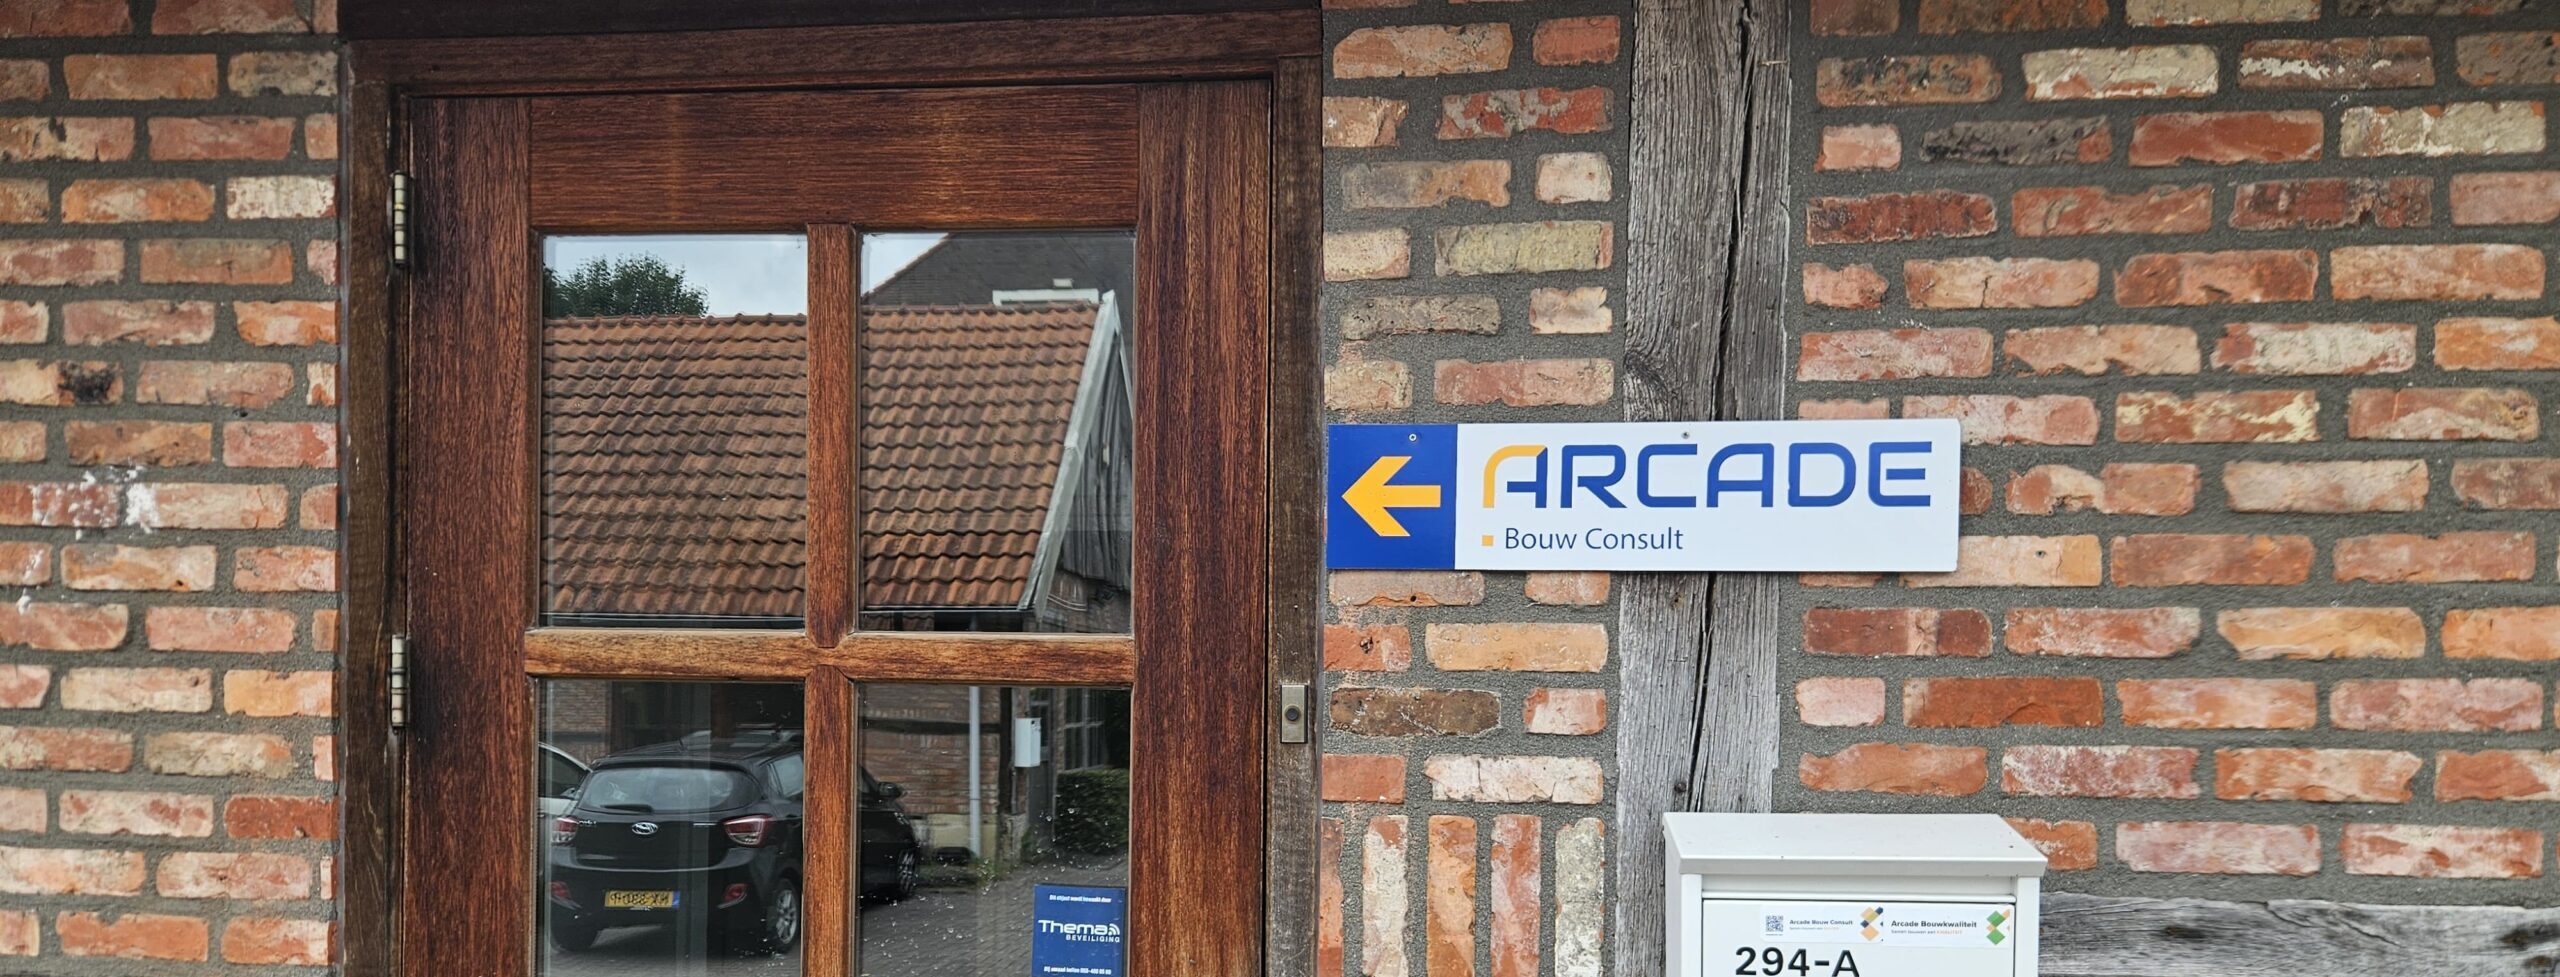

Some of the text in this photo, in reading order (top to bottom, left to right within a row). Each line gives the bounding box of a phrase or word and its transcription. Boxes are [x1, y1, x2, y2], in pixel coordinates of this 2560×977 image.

[1483, 441, 1932, 508] ARCADE
[1504, 527, 1684, 550] Bouw Consult
[1038, 920, 1108, 935] Thema
[1891, 920, 1978, 929] Arcade Bouwkwaliteit
[1065, 935, 1120, 943] BEVEILIGING
[1735, 946, 1860, 977] 294-A
